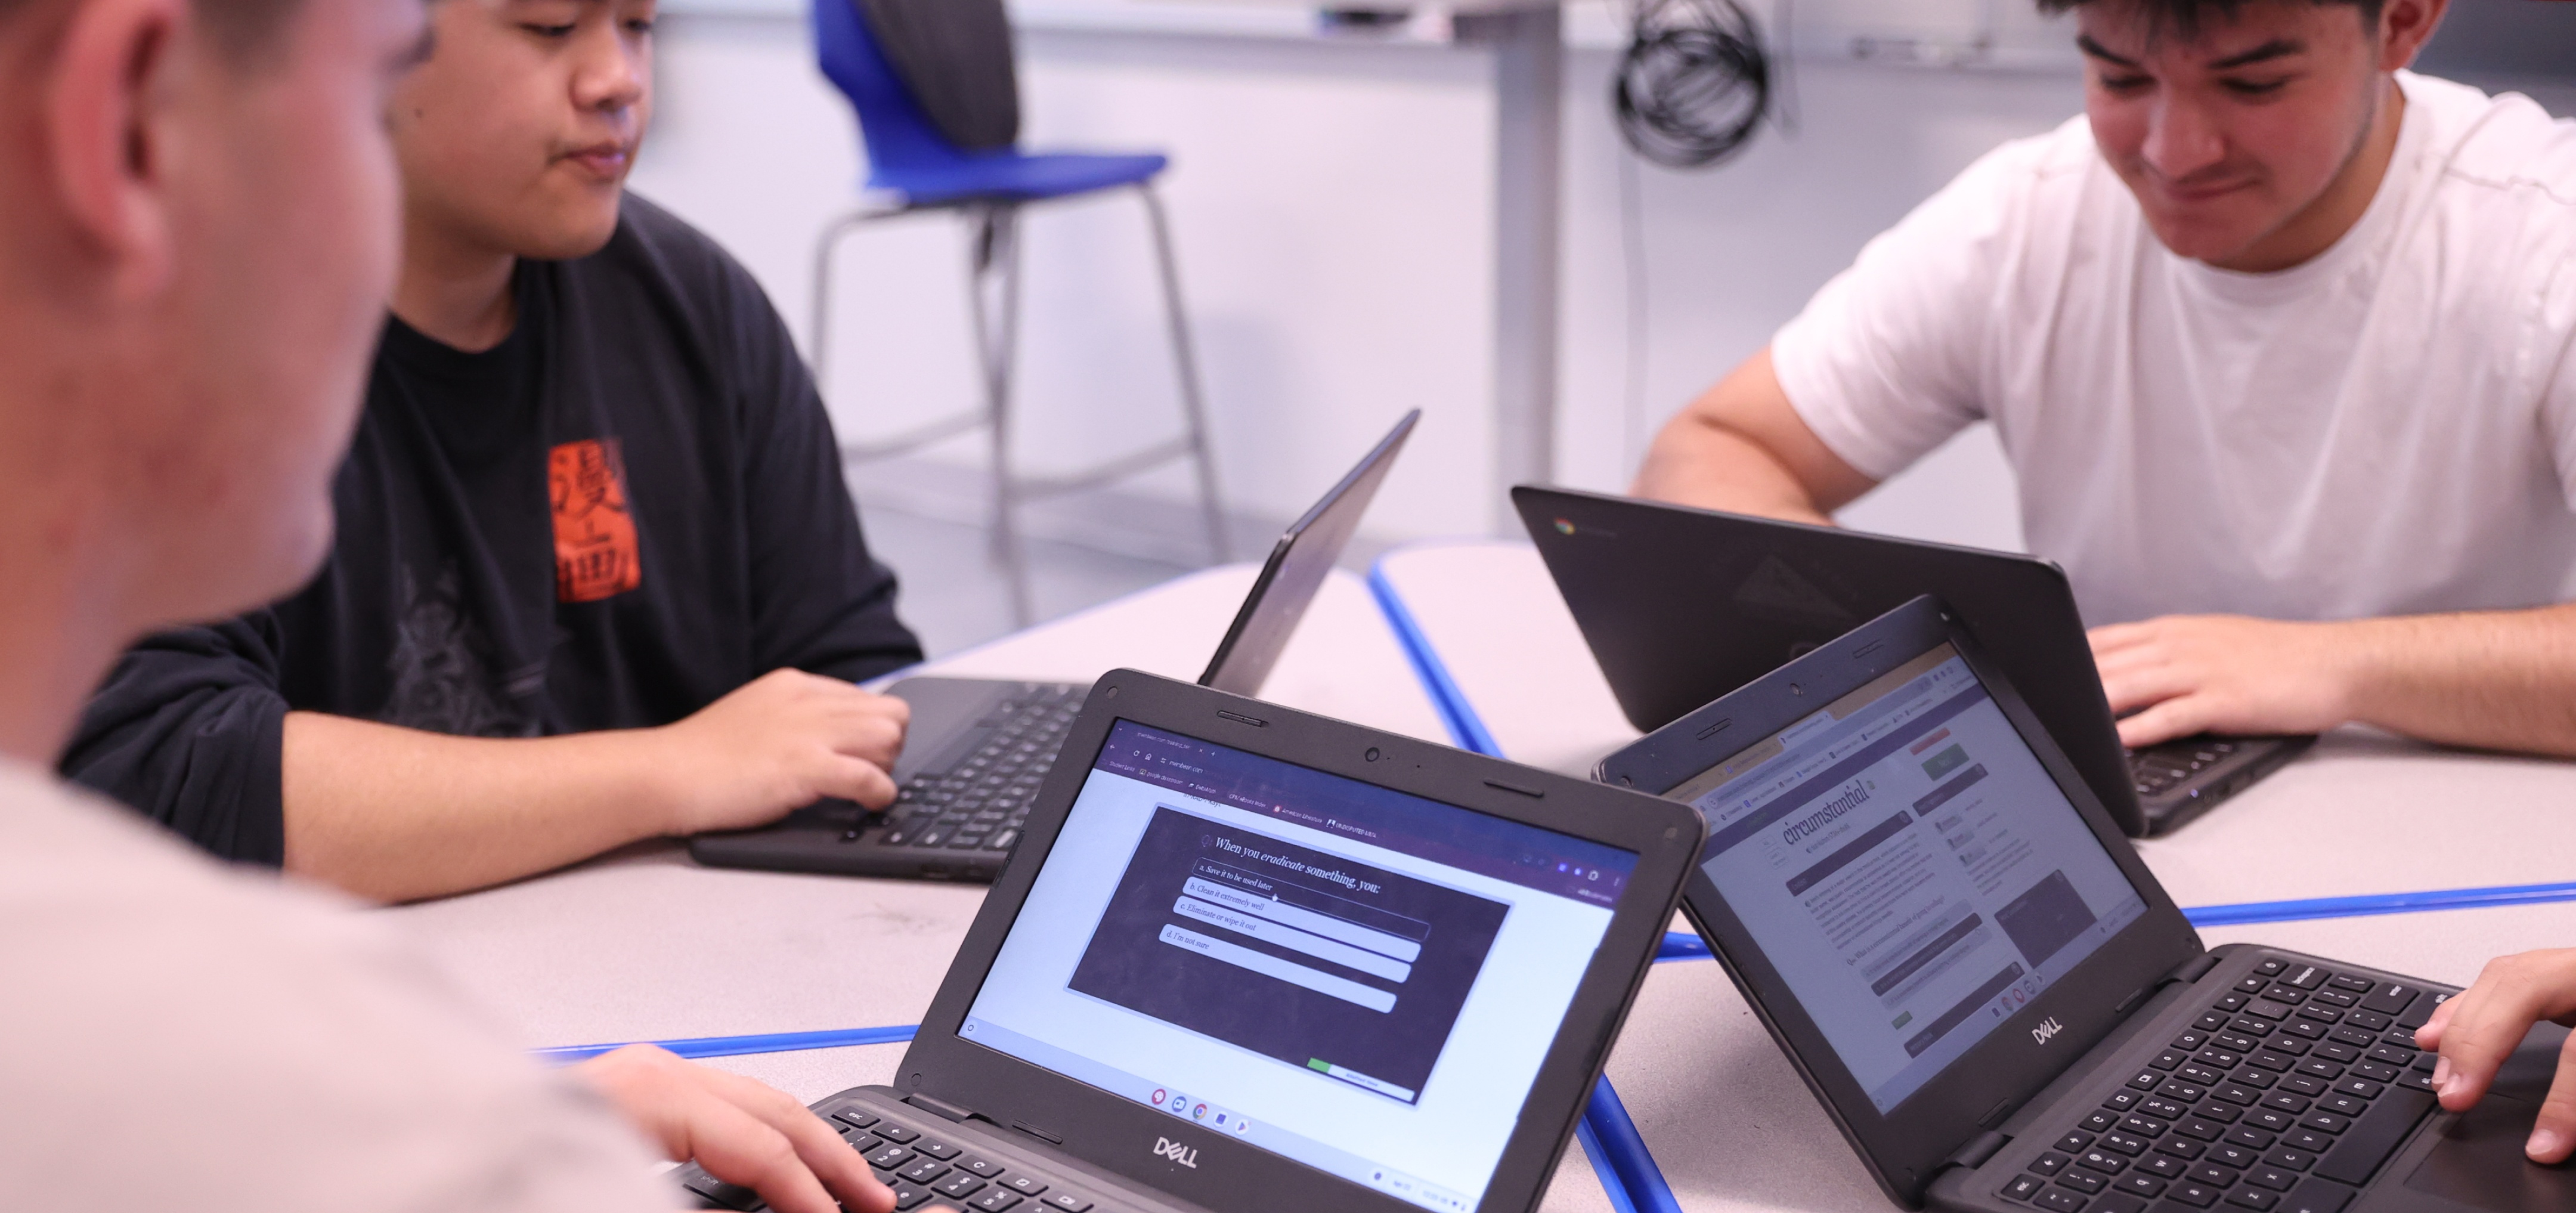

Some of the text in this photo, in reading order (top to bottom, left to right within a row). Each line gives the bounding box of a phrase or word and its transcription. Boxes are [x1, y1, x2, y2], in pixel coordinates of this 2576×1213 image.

[1783, 779, 1869, 844] circumstantial
[1215, 837, 1241, 853] When
[1240, 847, 1260, 859] you
[1260, 853, 1305, 871] eradicate
[1305, 865, 1356, 889] something,
[1356, 880, 1380, 893] you:
[1205, 865, 1221, 875] Save
[1220, 869, 1227, 877] it
[1233, 872, 1242, 881] be
[1241, 877, 1259, 887] used
[1256, 880, 1272, 891] later
[1189, 881, 1265, 911] b. Clean it extremely well
[1186, 903, 1216, 918] Eliminate
[1224, 916, 1239, 926] wipe
[1239, 919, 1245, 927] it
[1166, 930, 1209, 949] d. I'm not sure
[2031, 1016, 2063, 1045] DELL
[2352, 1082, 2366, 1090] m
[848, 1112, 863, 1120] esc
[2264, 1114, 2277, 1122] g
[1153, 1136, 1198, 1169] DELL
[2225, 1150, 2238, 1158] d
[2154, 1159, 2168, 1168] w
[911, 1168, 924, 1177] 3
[2135, 1178, 2150, 1186] q
[899, 1191, 911, 1199] e
[2247, 1192, 2260, 1200] z
[983, 1197, 995, 1206] 5
